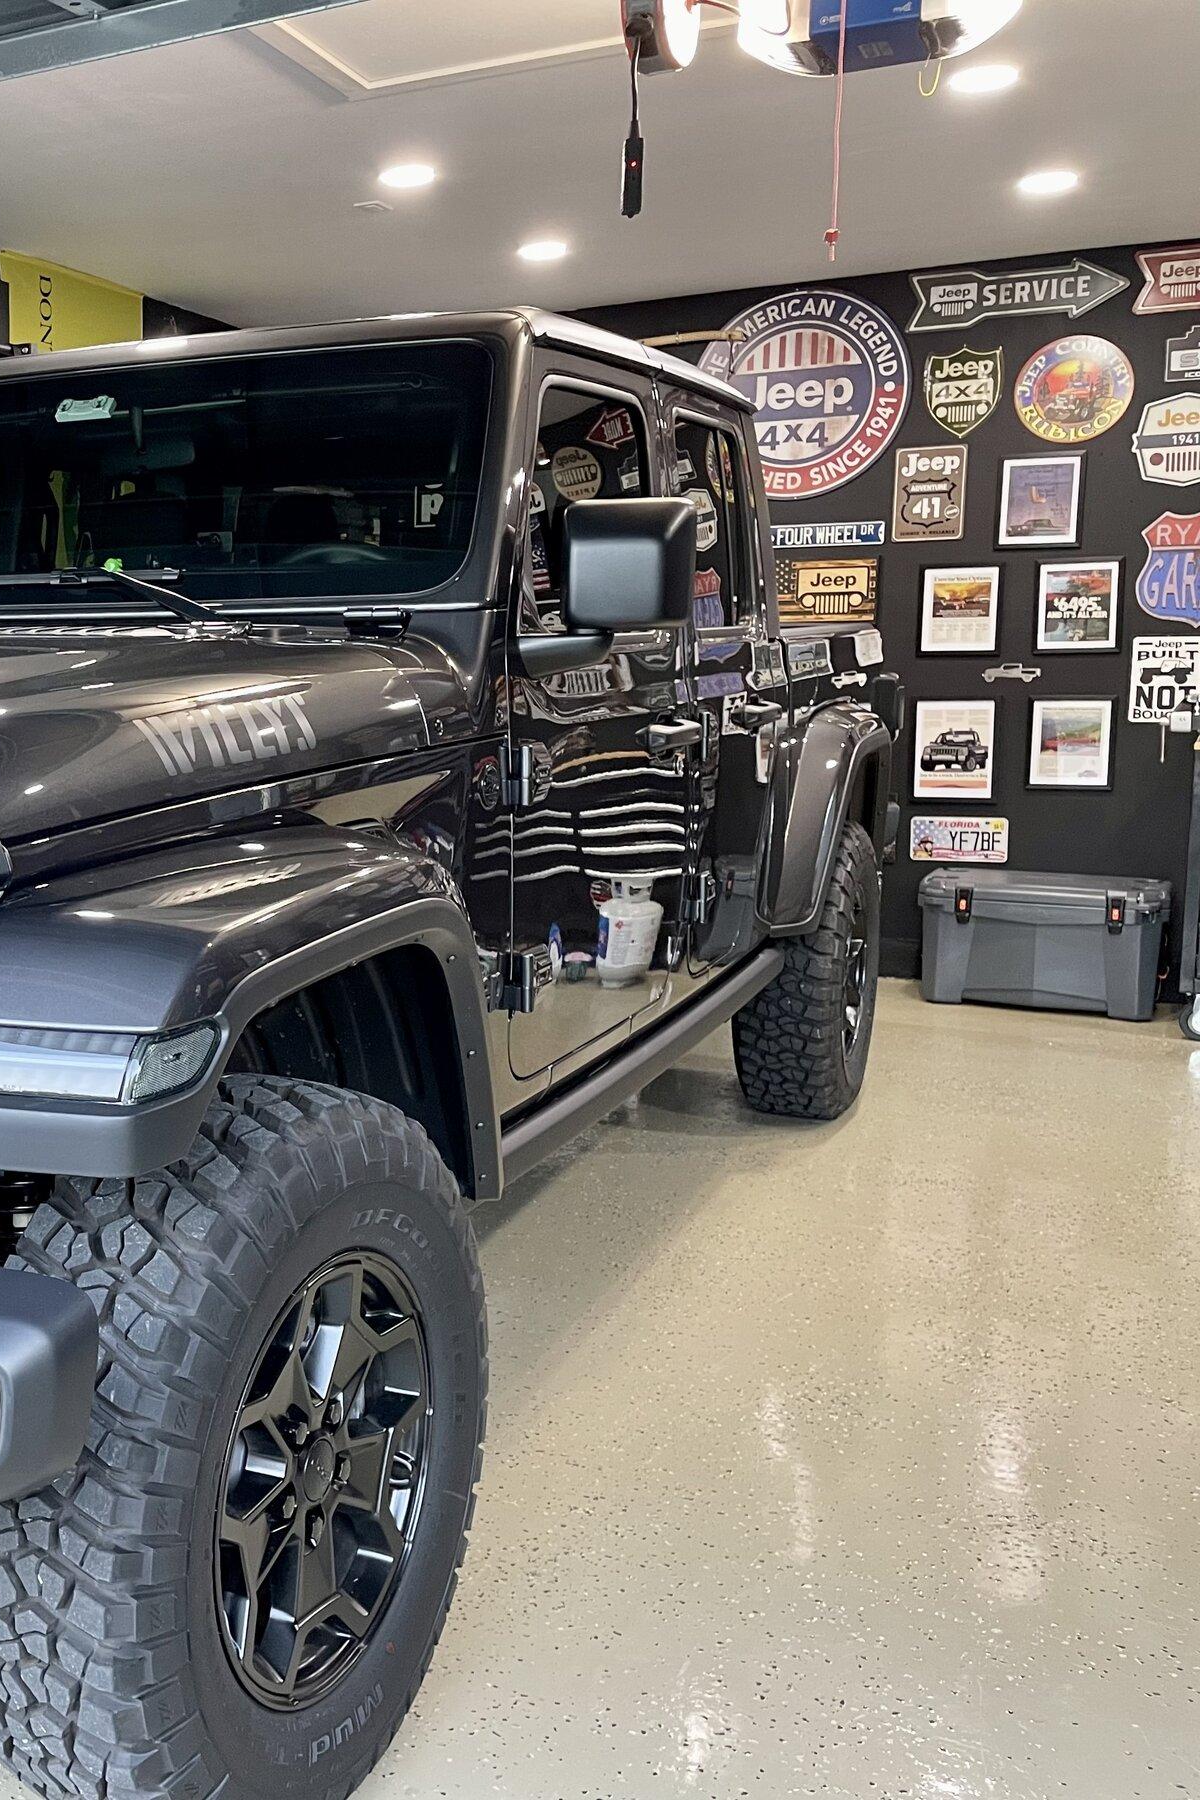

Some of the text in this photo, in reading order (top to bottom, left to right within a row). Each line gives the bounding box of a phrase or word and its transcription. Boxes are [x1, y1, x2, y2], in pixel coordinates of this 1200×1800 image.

[938, 275, 1091, 307] Jeep SERVICE
[839, 305, 898, 377] LEGEND
[935, 359, 995, 379] Jeep
[1017, 355, 1046, 397] JEEP
[754, 376, 854, 414] Jeep
[1021, 397, 1124, 441] RUBICON
[1157, 408, 1200, 427] Jee
[809, 397, 898, 486] SINCE 1941
[1171, 433, 1200, 445] 1941
[901, 453, 961, 478] Jeep
[910, 482, 948, 493] ADVENTURE
[912, 497, 941, 519] 41
[776, 524, 875, 546] FOUR WHEEL DR
[810, 573, 857, 589] Jeep
[1143, 552, 1200, 609] GAR
[1155, 640, 1182, 648] Jeep
[1137, 650, 1199, 661] BUILT
[1135, 685, 1197, 710] NOT
[132, 692, 317, 776] WILLYS
[938, 821, 980, 829] FLORIDA
[949, 830, 1002, 852] YF7BF
